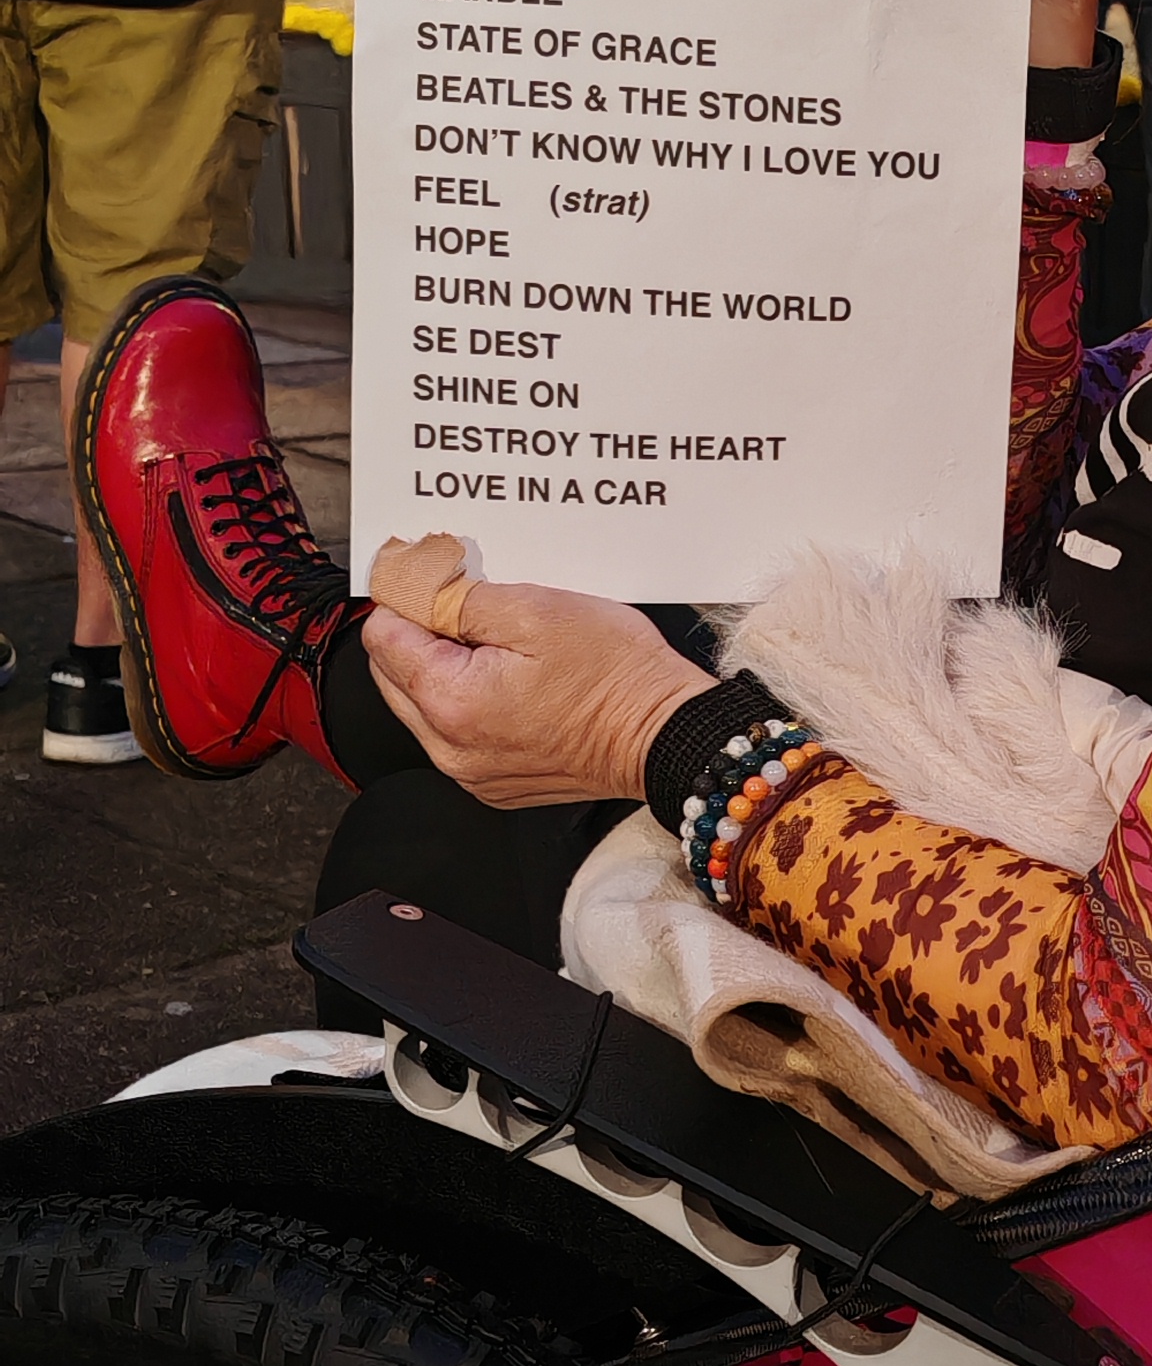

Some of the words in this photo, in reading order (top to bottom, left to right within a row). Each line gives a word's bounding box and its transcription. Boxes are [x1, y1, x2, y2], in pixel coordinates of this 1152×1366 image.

[416, 21, 523, 56] STATE
[533, 28, 581, 58] OF
[591, 31, 717, 67] GRACE
[416, 73, 573, 111] BEATLES
[583, 84, 608, 113] &
[618, 86, 688, 118] THE
[698, 90, 842, 127] STONES
[532, 131, 642, 165] KNOW
[651, 139, 734, 171] WHY
[743, 144, 751, 172] I
[763, 145, 857, 177] LOVE
[866, 150, 941, 181] YOU
[414, 175, 501, 208] FEEL
[549, 184, 650, 224] (strat)
[415, 224, 510, 258] HOPE
[414, 274, 511, 308] BURN
[523, 281, 632, 315] DOWN
[642, 288, 712, 319] THE
[722, 292, 852, 322] WORLD
[412, 324, 458, 354] SE
[469, 328, 562, 360] DEST
[412, 373, 518, 406] SHINE
[529, 380, 579, 409] ON
[414, 423, 580, 458] DESTROY
[589, 431, 659, 460] THE
[670, 435, 787, 461] HEART
[414, 470, 507, 501] LOVE
[518, 476, 550, 503] IN
[560, 478, 585, 504] A
[594, 479, 667, 506] CAR
